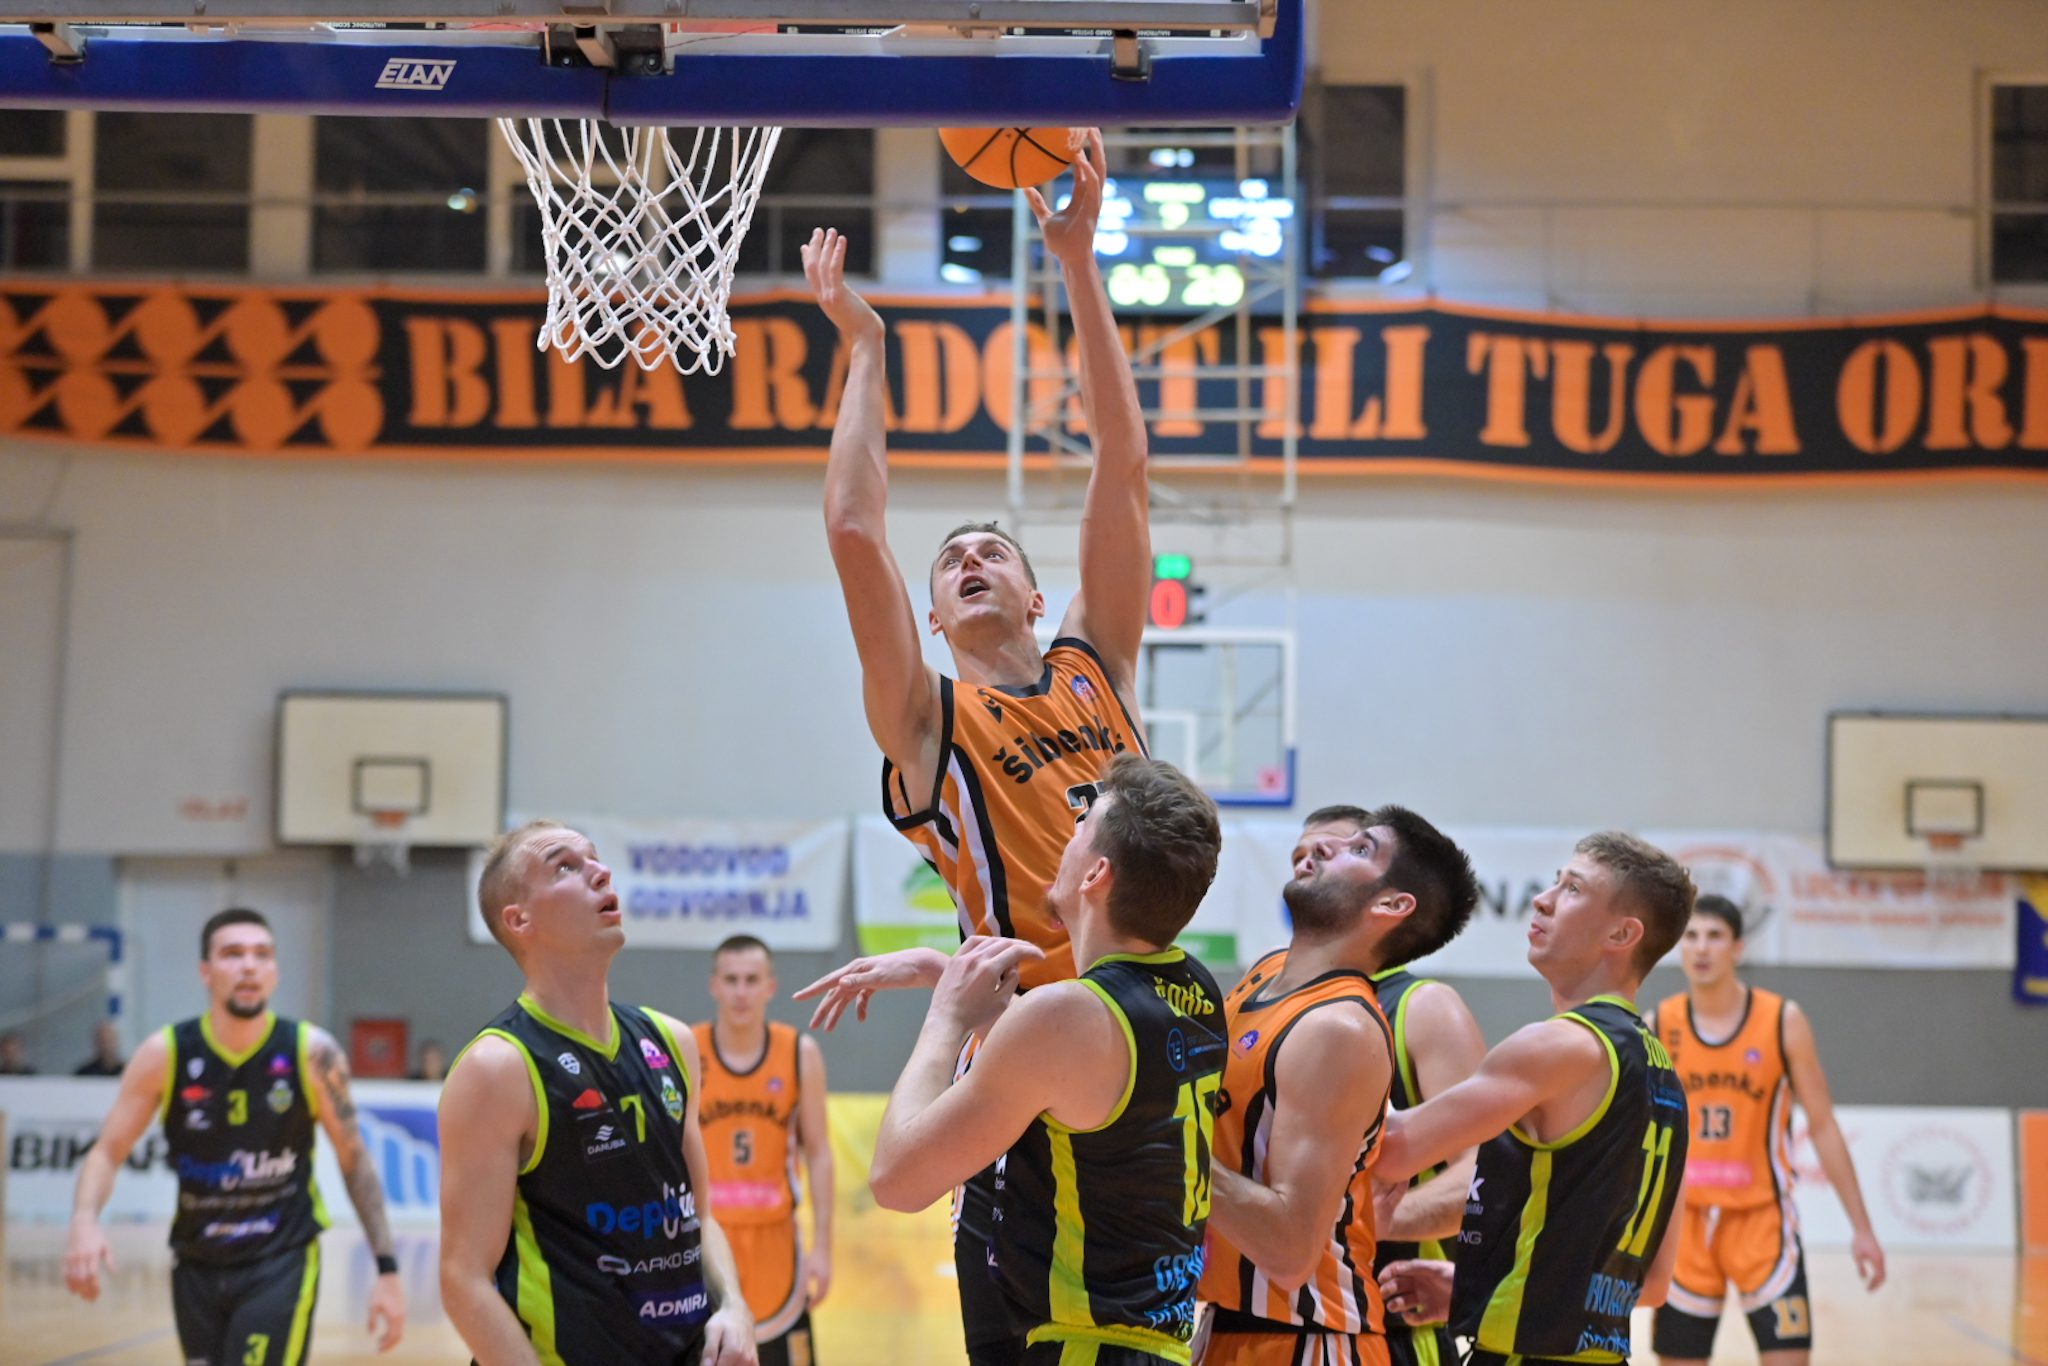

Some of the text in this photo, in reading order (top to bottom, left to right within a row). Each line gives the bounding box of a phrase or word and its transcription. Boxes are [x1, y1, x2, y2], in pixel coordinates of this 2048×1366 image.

[377, 63, 455, 85] ELAN
[404, 315, 694, 431] BILA
[1256, 325, 1431, 441] ILI
[1466, 332, 1802, 457] TUGA
[627, 844, 790, 876] VODOVOD
[227, 1089, 248, 1126] 3
[620, 1094, 646, 1143] 7
[1700, 1105, 1732, 1139] 13
[733, 1130, 754, 1166] 5
[1616, 1119, 1673, 1257] 11
